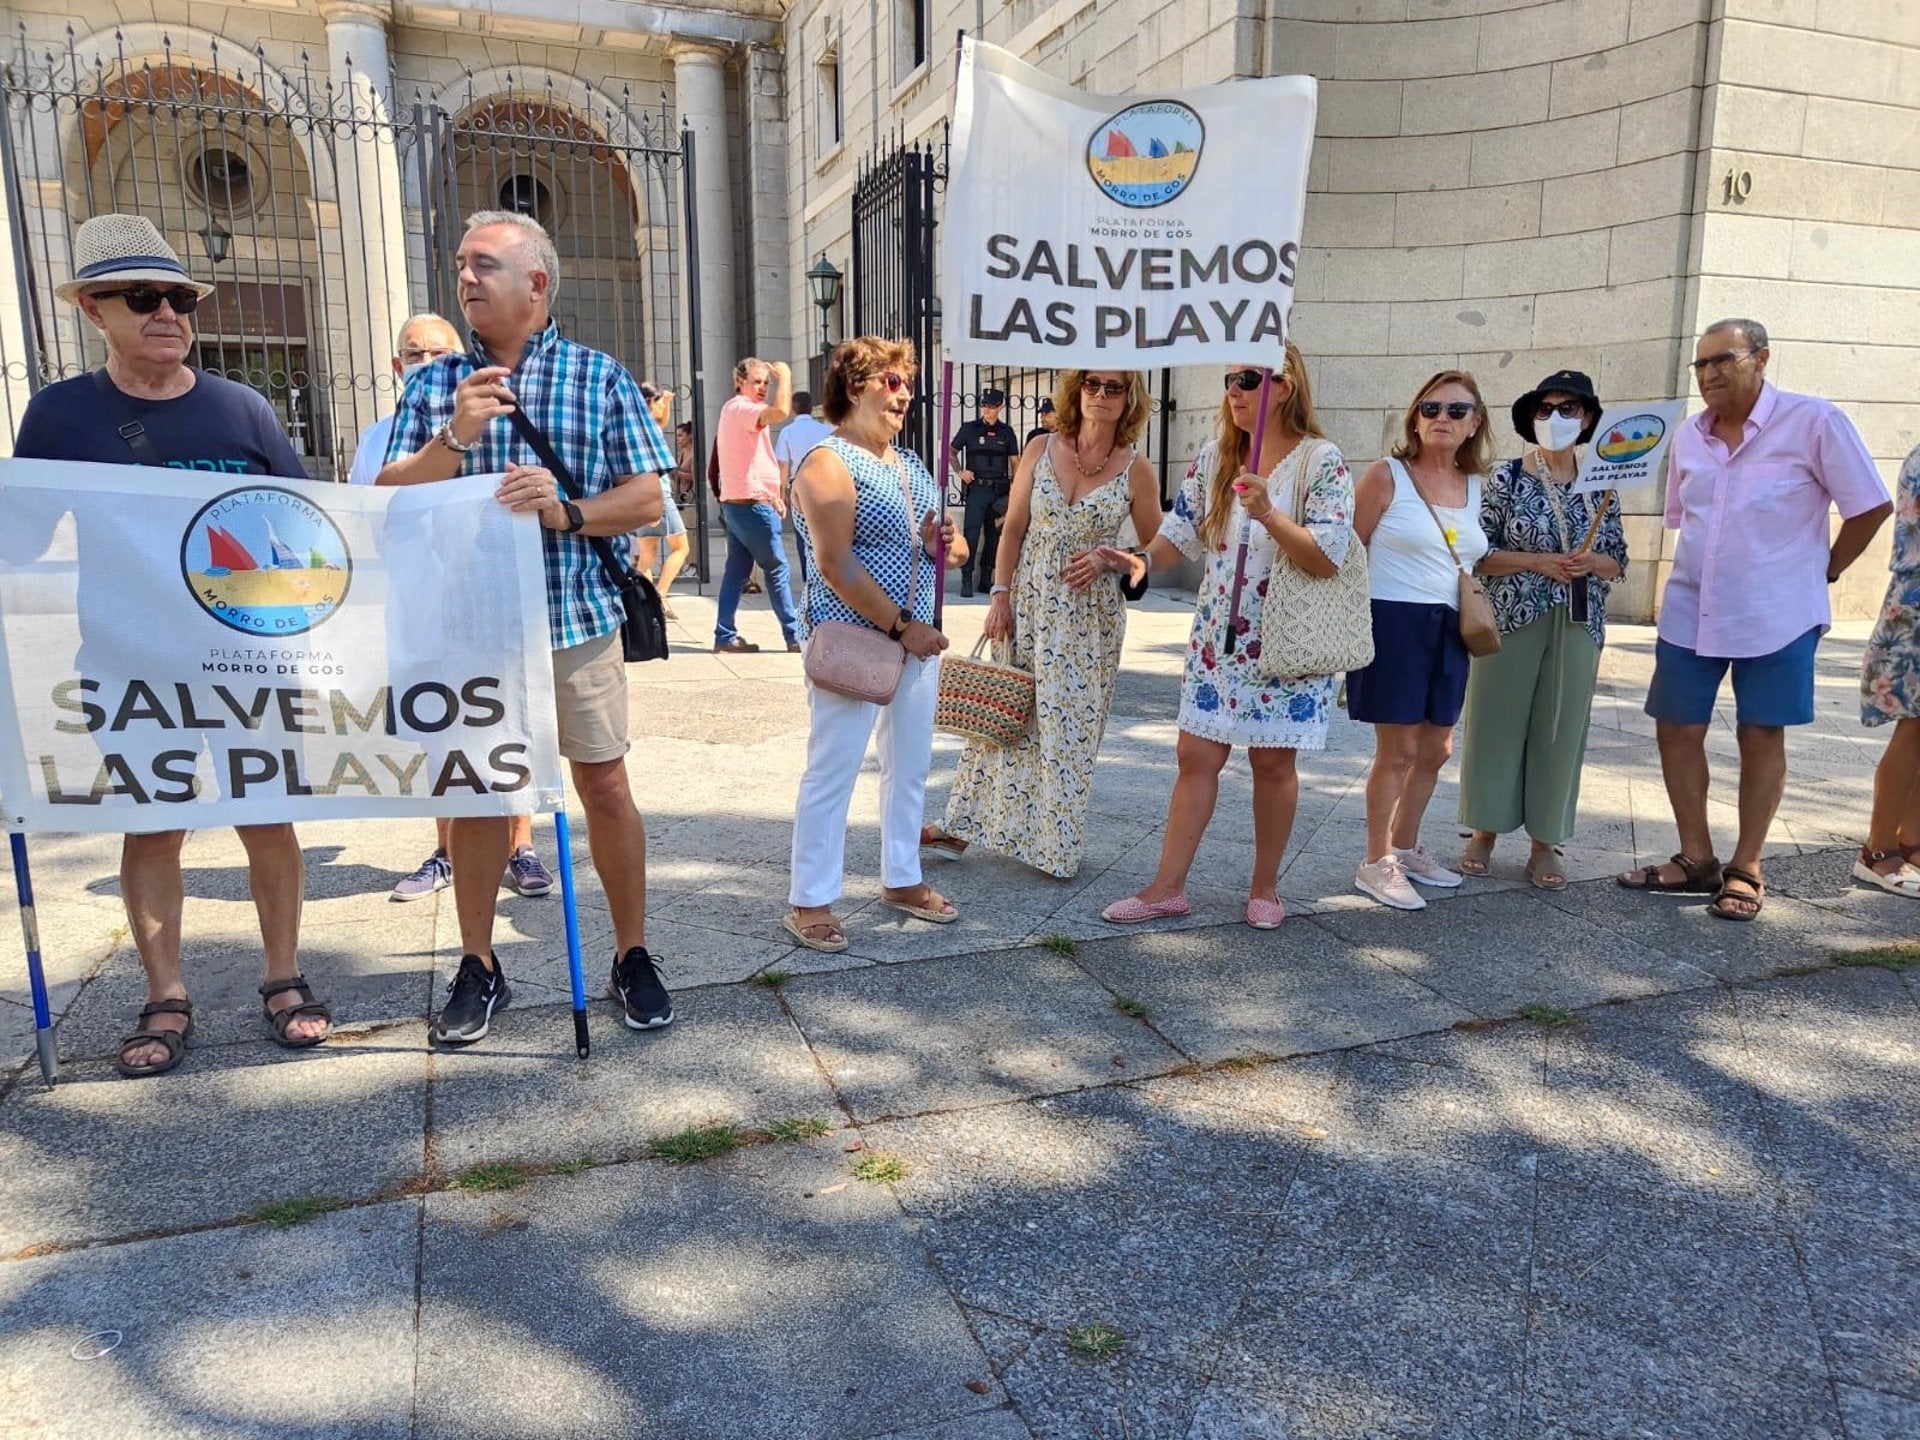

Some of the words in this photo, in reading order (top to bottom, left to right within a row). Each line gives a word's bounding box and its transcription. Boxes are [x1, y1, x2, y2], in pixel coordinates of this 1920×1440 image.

[1113, 104, 1195, 127] PLATAFORMA
[1096, 169, 1138, 201] MORRO
[1143, 192, 1160, 202] DE
[1164, 172, 1186, 195] GOS
[1723, 168, 1753, 203] 10
[1091, 228, 1138, 238] MORRO
[1144, 229, 1160, 239] DE
[1166, 229, 1193, 239] GOS
[1096, 216, 1185, 228] PLATAFORMA
[986, 234, 1297, 290] SALVEMOS
[969, 294, 1077, 347] LAS
[1095, 299, 1292, 349] PLAYA
[1584, 474, 1605, 482] LAS
[1608, 471, 1648, 480] PLAYAS
[1591, 462, 1648, 473] SALVEMOS
[210, 492, 324, 528] PLATAFORMA
[203, 588, 266, 628] MORRO
[275, 616, 299, 629] DE
[202, 662, 268, 675] MORRO
[277, 663, 299, 675] DE
[309, 664, 345, 676] GOS
[210, 648, 334, 662] PLATAFORMA
[49, 676, 506, 736] SALVEMOS
[39, 748, 201, 805] LAS
[227, 742, 532, 799] PLAYAS
